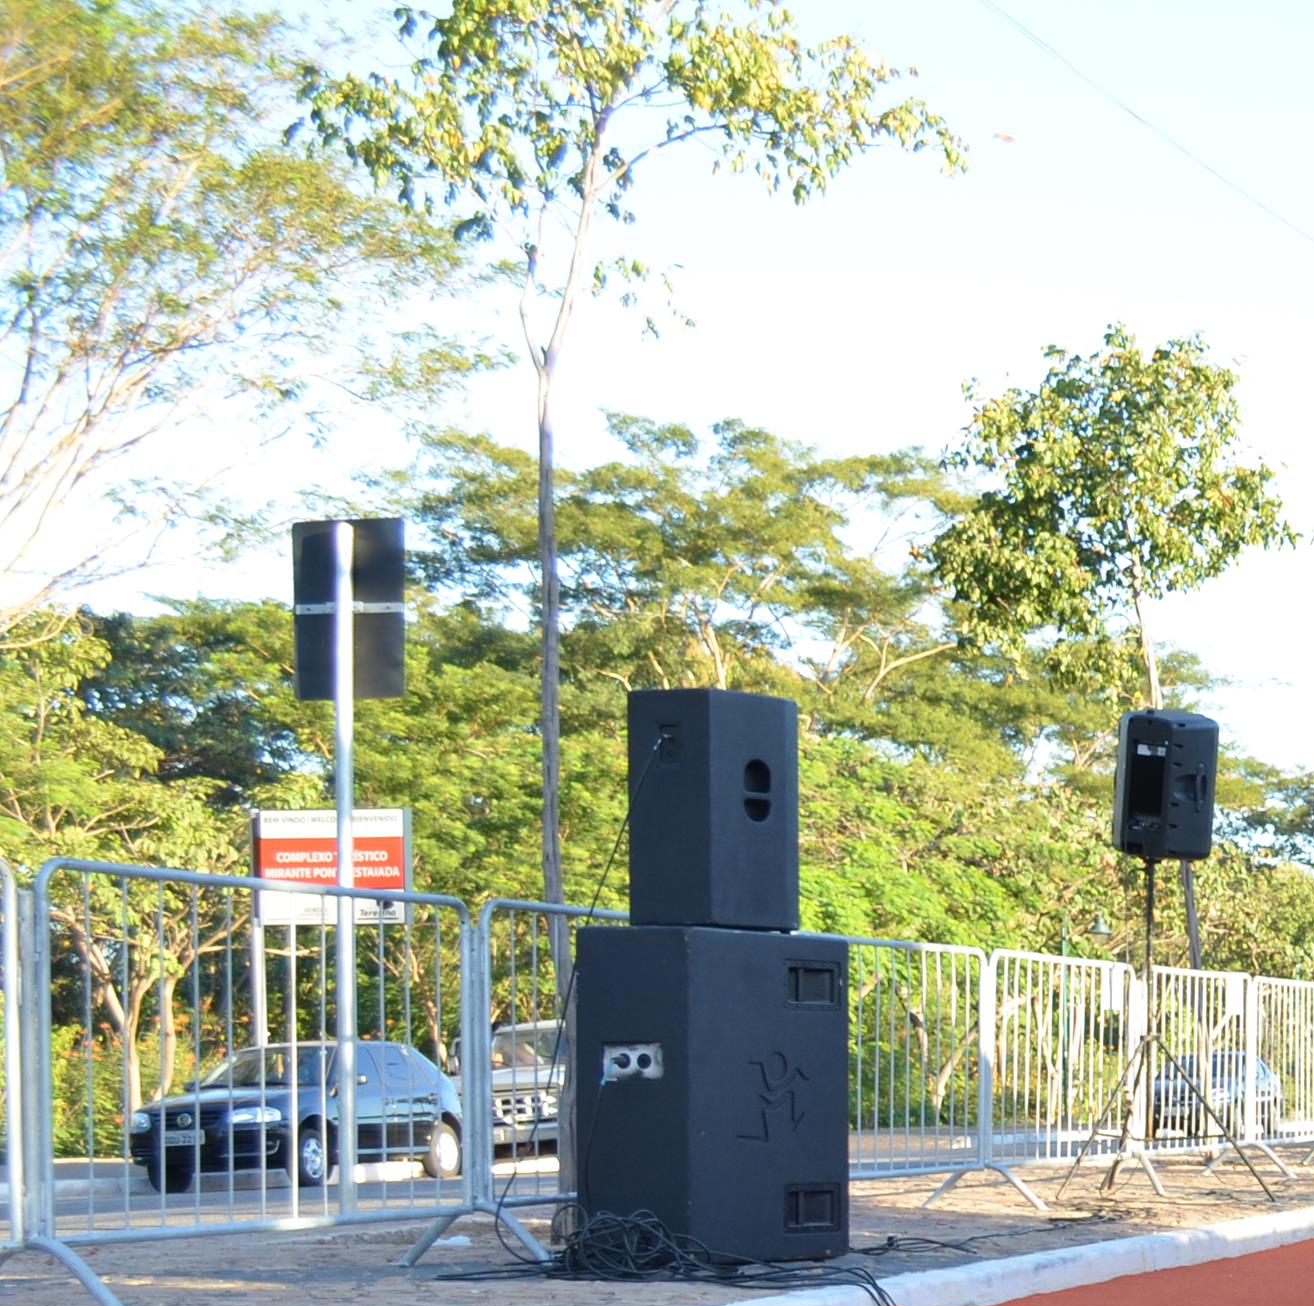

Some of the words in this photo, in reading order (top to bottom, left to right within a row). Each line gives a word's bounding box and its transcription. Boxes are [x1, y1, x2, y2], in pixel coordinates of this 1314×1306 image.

[311, 815, 337, 824] WELCO
[276, 851, 332, 863] COMPLEXO
[265, 867, 311, 878] MIRANTE
[313, 867, 337, 878] PON
